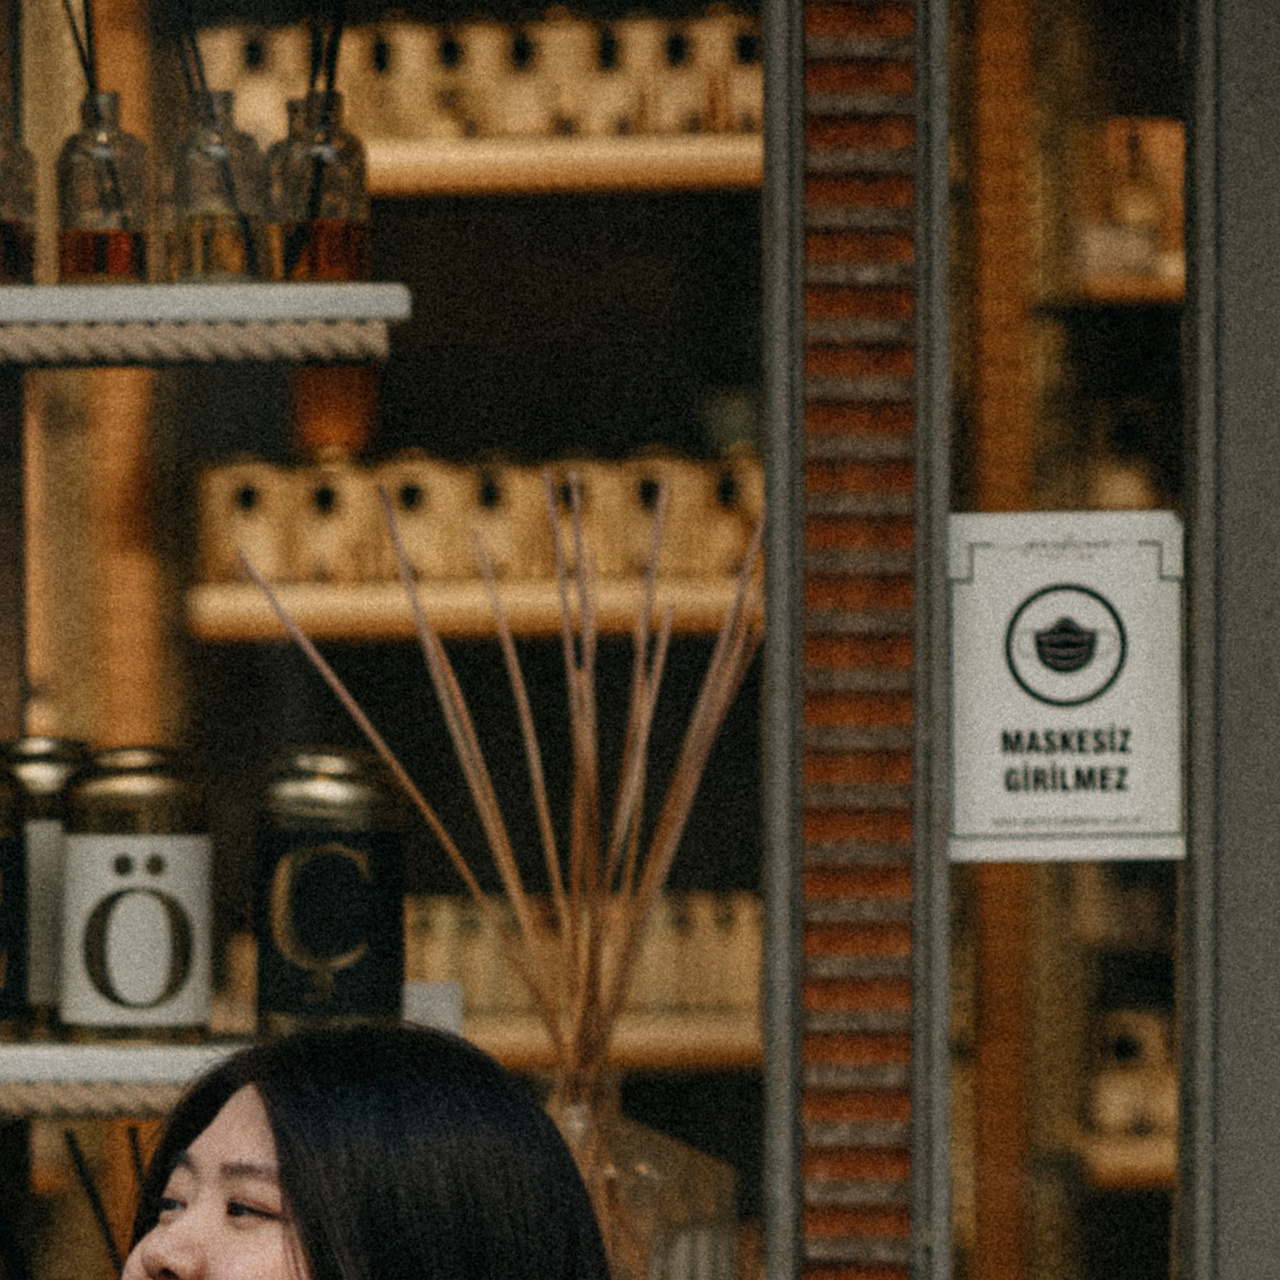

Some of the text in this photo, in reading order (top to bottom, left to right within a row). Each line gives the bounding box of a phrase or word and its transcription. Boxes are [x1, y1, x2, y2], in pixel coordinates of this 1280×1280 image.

[1002, 723, 1132, 754] MASKESİZ
[1004, 761, 1129, 793] GİRİLMEZ
[84, 853, 193, 1010] Ö
[269, 841, 371, 1005] Ç
